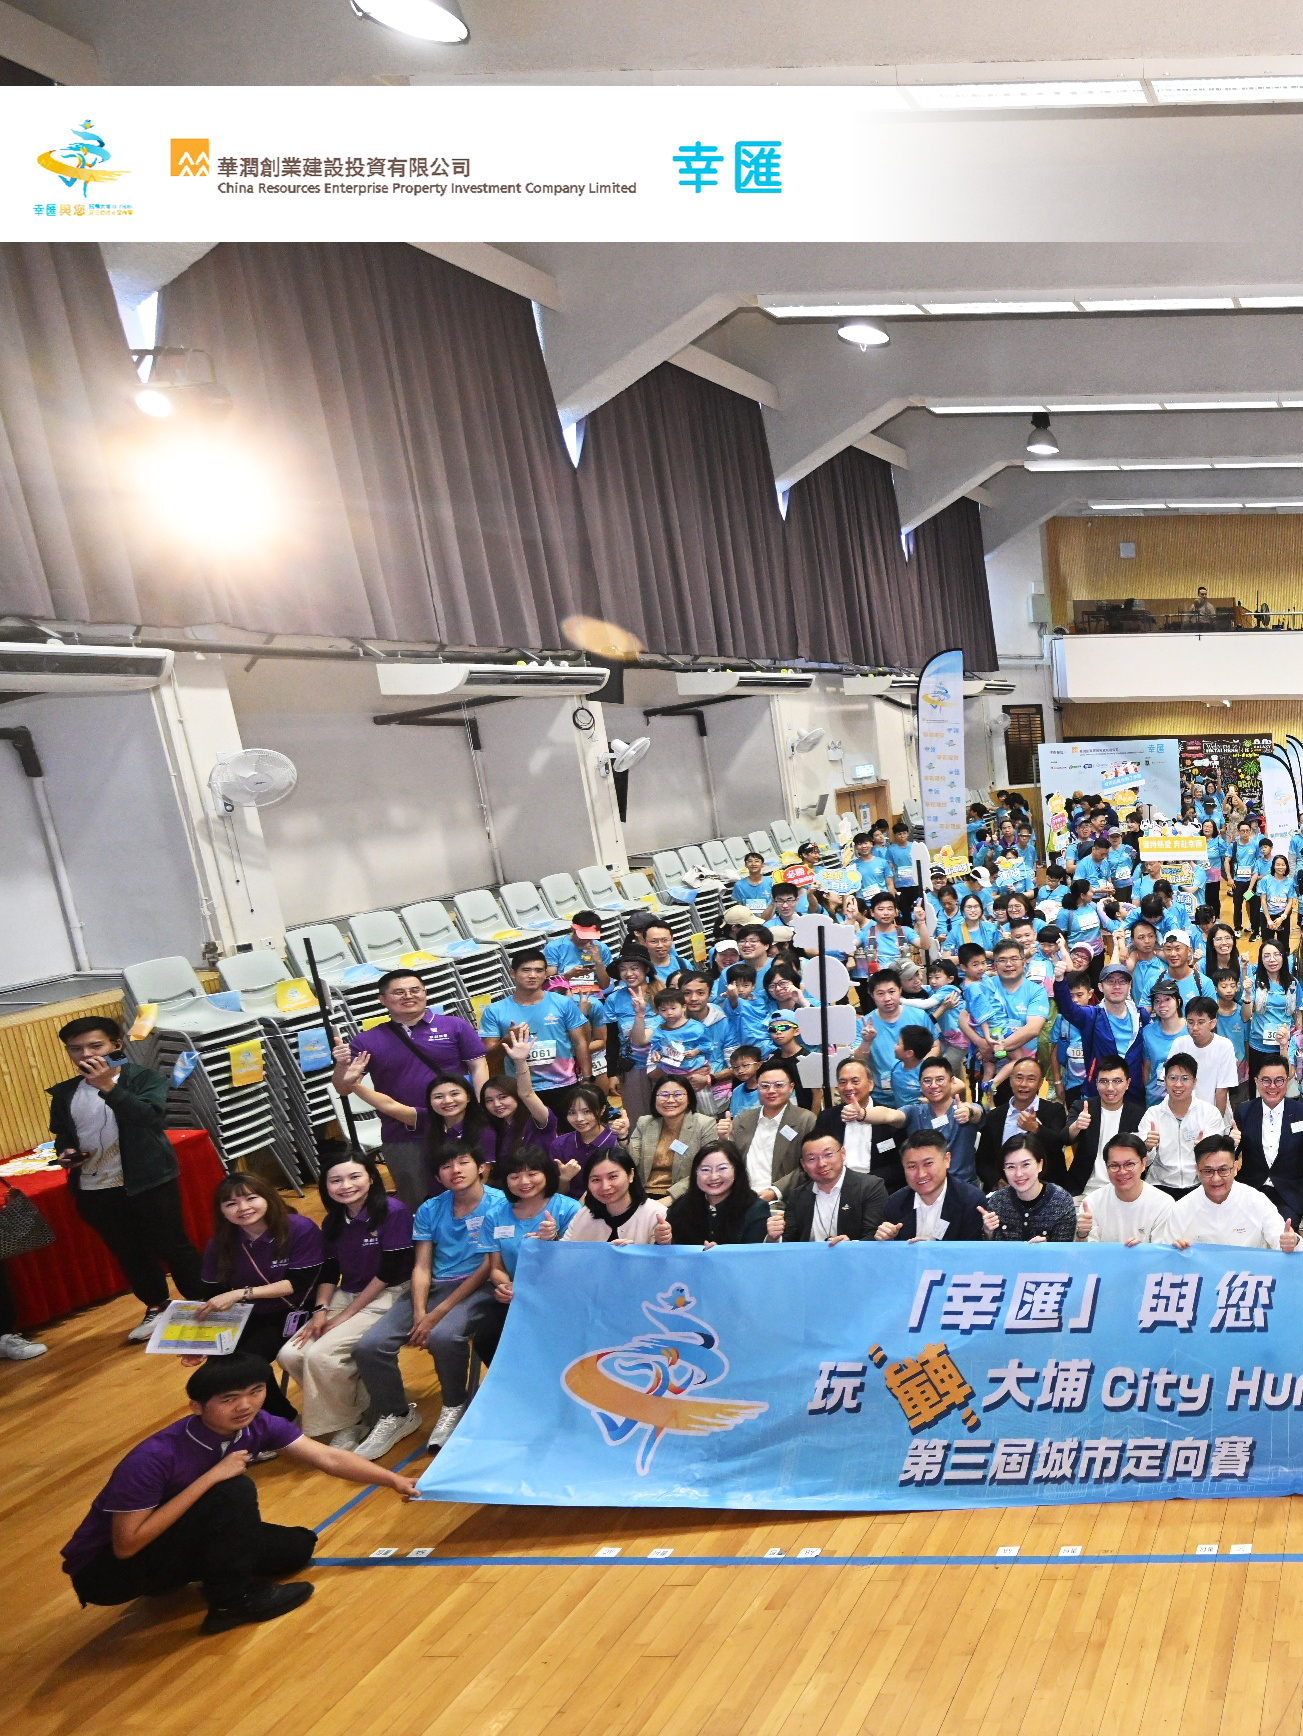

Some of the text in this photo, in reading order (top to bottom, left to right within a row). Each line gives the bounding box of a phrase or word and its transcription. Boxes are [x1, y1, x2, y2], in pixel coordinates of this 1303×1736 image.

[1101, 1366, 1215, 1417] City
[899, 1435, 1258, 1488] 第三屆城市定向賽
